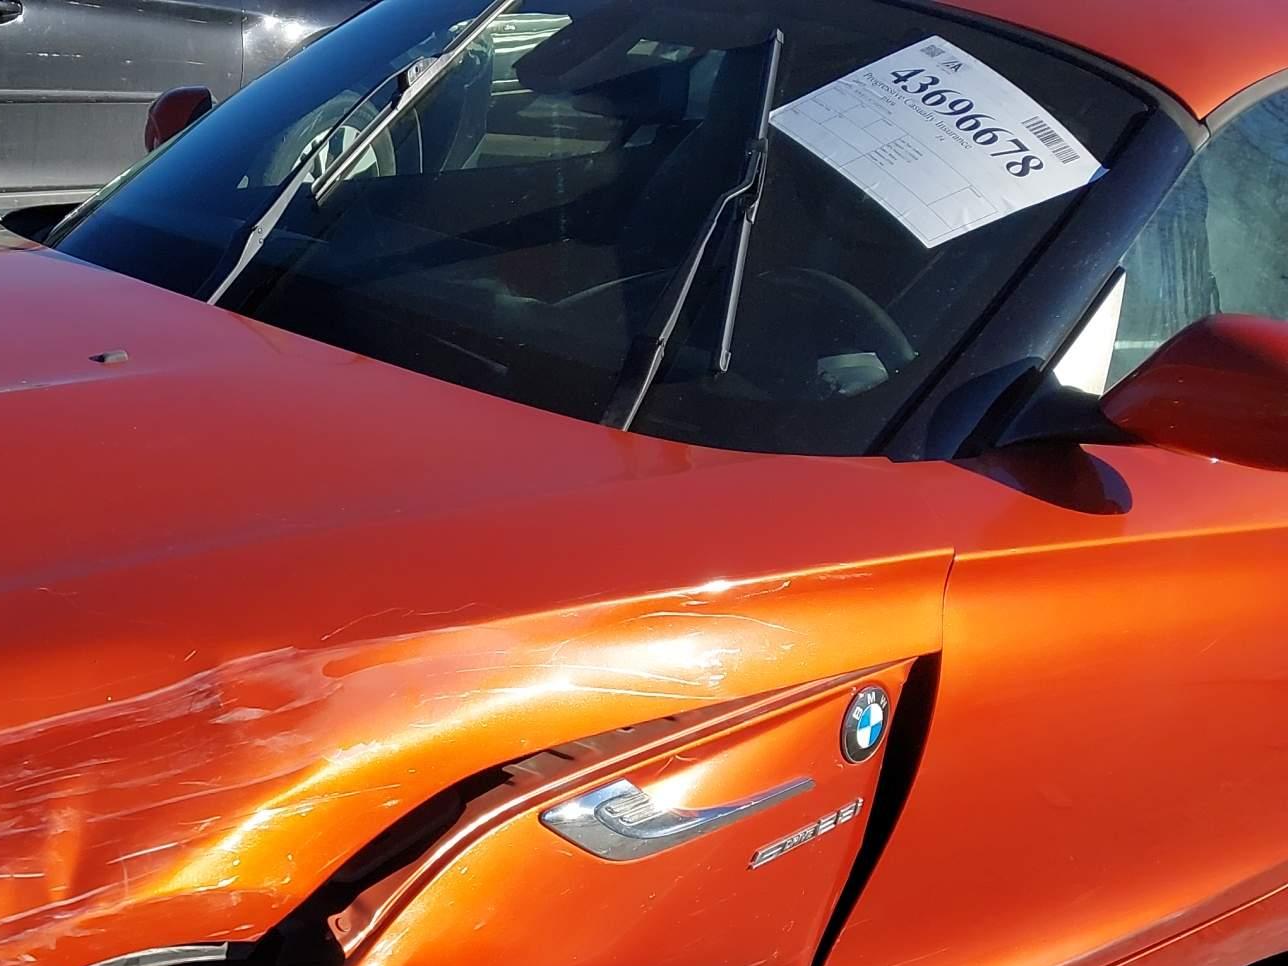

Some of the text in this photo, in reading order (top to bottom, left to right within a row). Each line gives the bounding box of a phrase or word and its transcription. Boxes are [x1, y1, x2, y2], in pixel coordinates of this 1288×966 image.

[863, 72, 906, 100] Progressive
[903, 98, 937, 122] Casualty
[935, 120, 973, 149] Insurance
[889, 67, 1044, 178] 43696678
[852, 691, 888, 721] BMW
